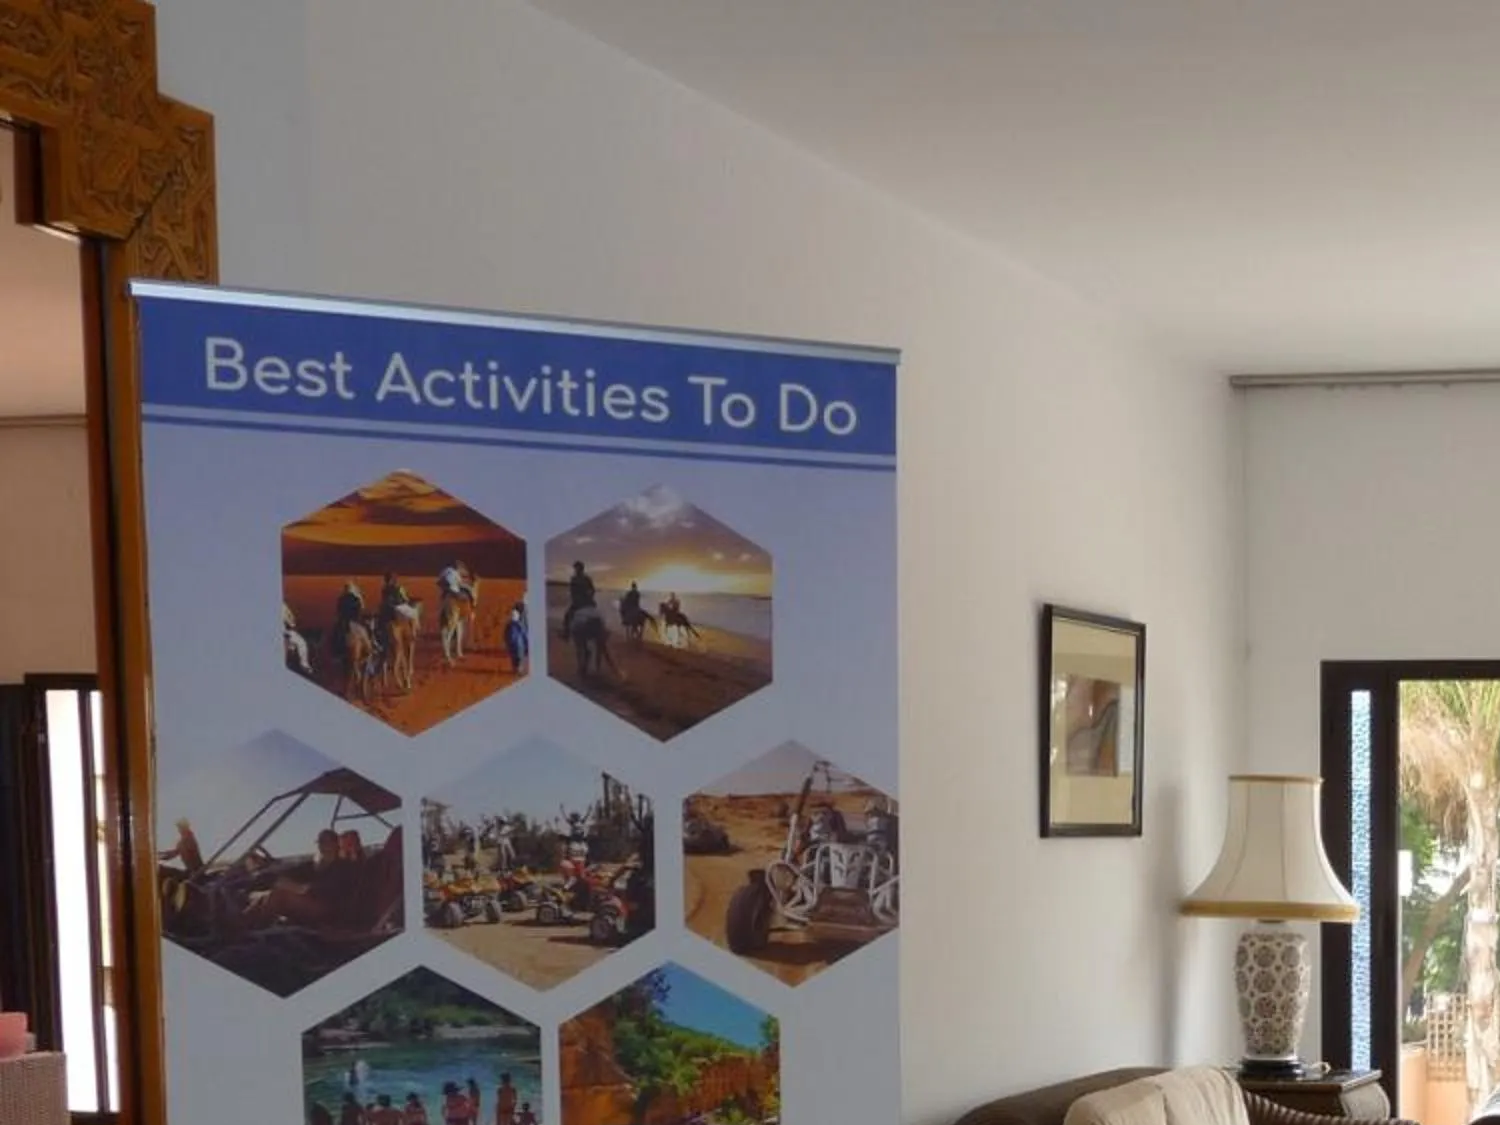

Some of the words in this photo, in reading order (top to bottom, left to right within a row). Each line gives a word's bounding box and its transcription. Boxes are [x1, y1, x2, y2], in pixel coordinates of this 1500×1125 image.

[205, 336, 355, 400] Best
[375, 352, 670, 423] Activities
[687, 375, 756, 428] To
[779, 383, 857, 435] Do
